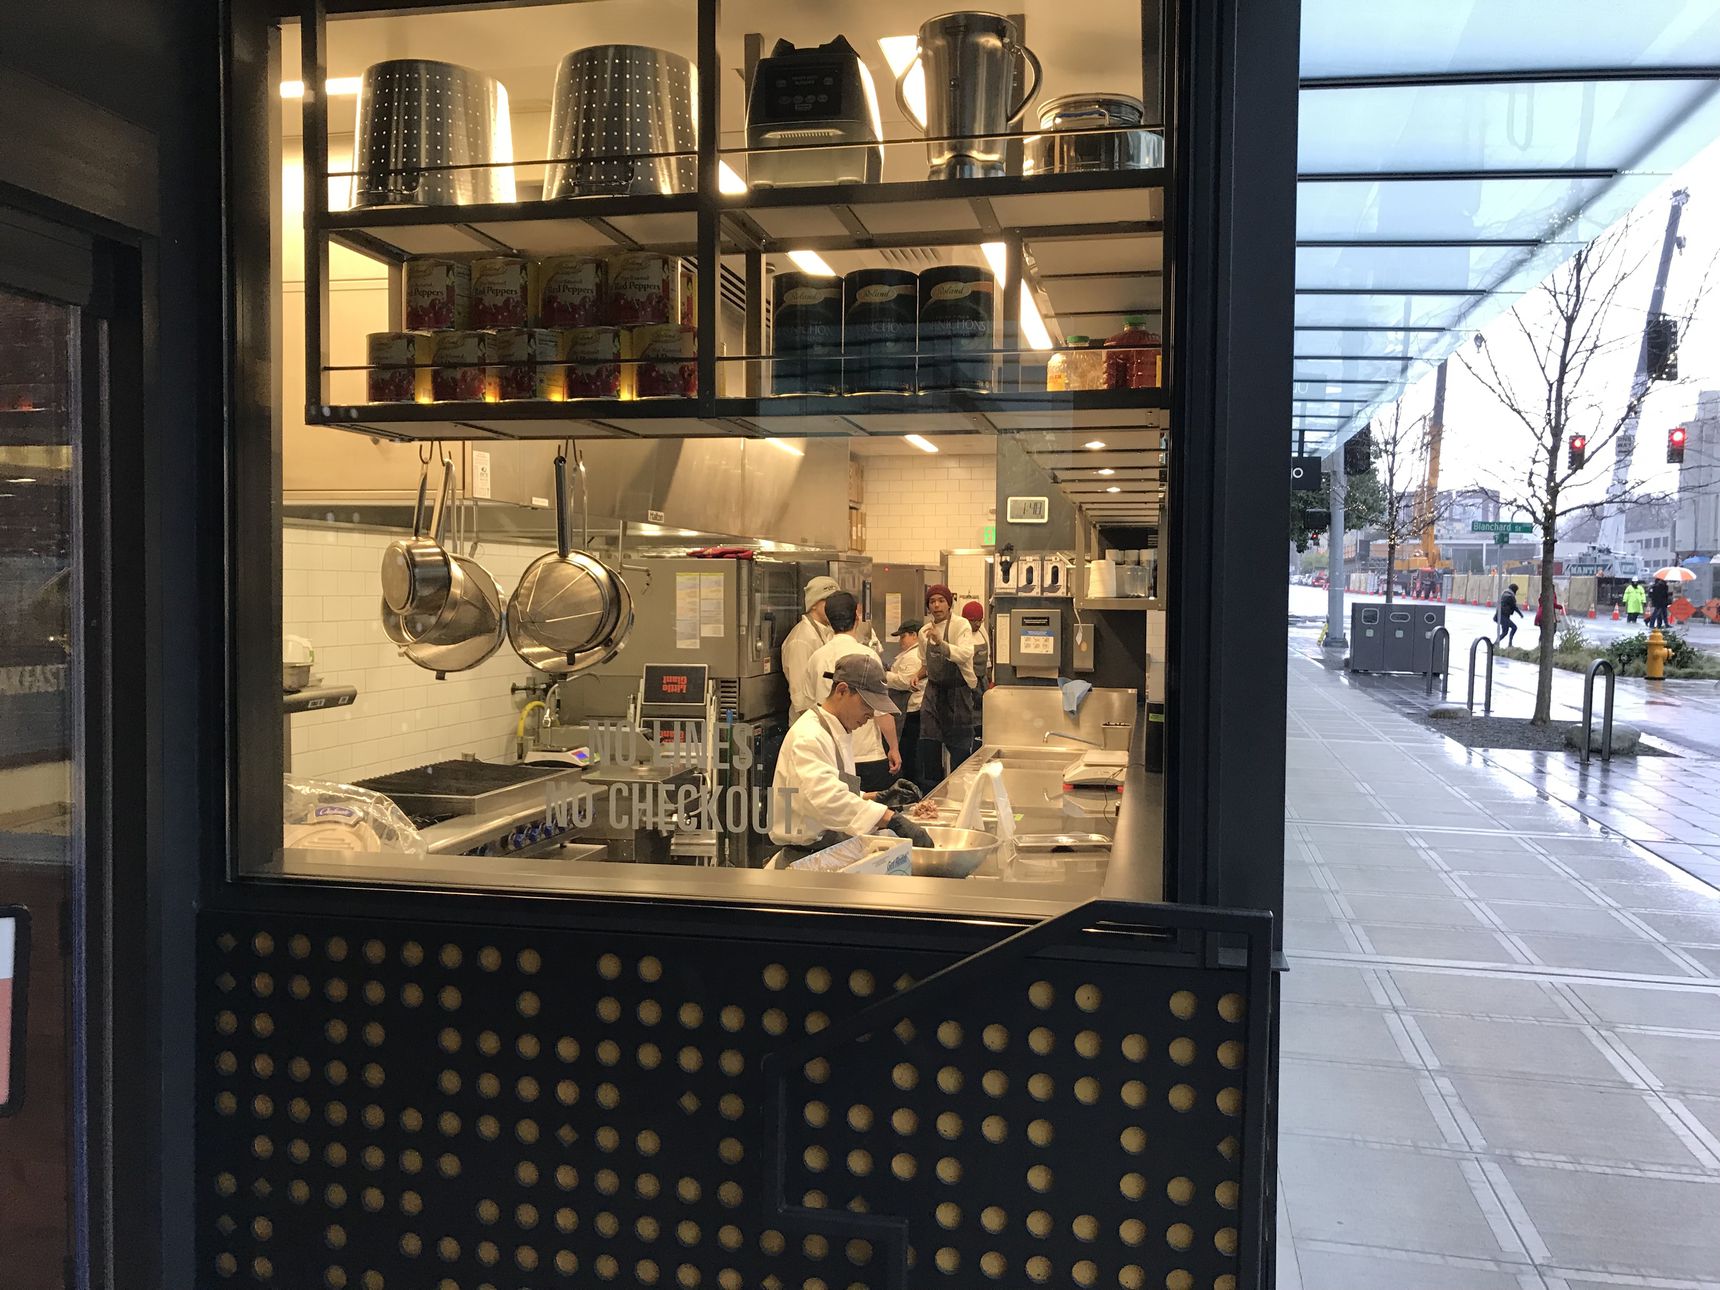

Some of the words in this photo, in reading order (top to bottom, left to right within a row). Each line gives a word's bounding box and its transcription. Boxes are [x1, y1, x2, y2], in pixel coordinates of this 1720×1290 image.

[487, 286, 518, 298] Peppers
[562, 284, 594, 296] Peppers
[629, 280, 660, 292] Peppers
[414, 288, 444, 299] Peppers
[1473, 521, 1512, 532] Blanchard
[662, 675, 688, 685] Giant
[662, 684, 687, 694] Little
[588, 719, 637, 767] NO
[545, 781, 593, 829] NO
[609, 782, 803, 835] CHECKOUT.
